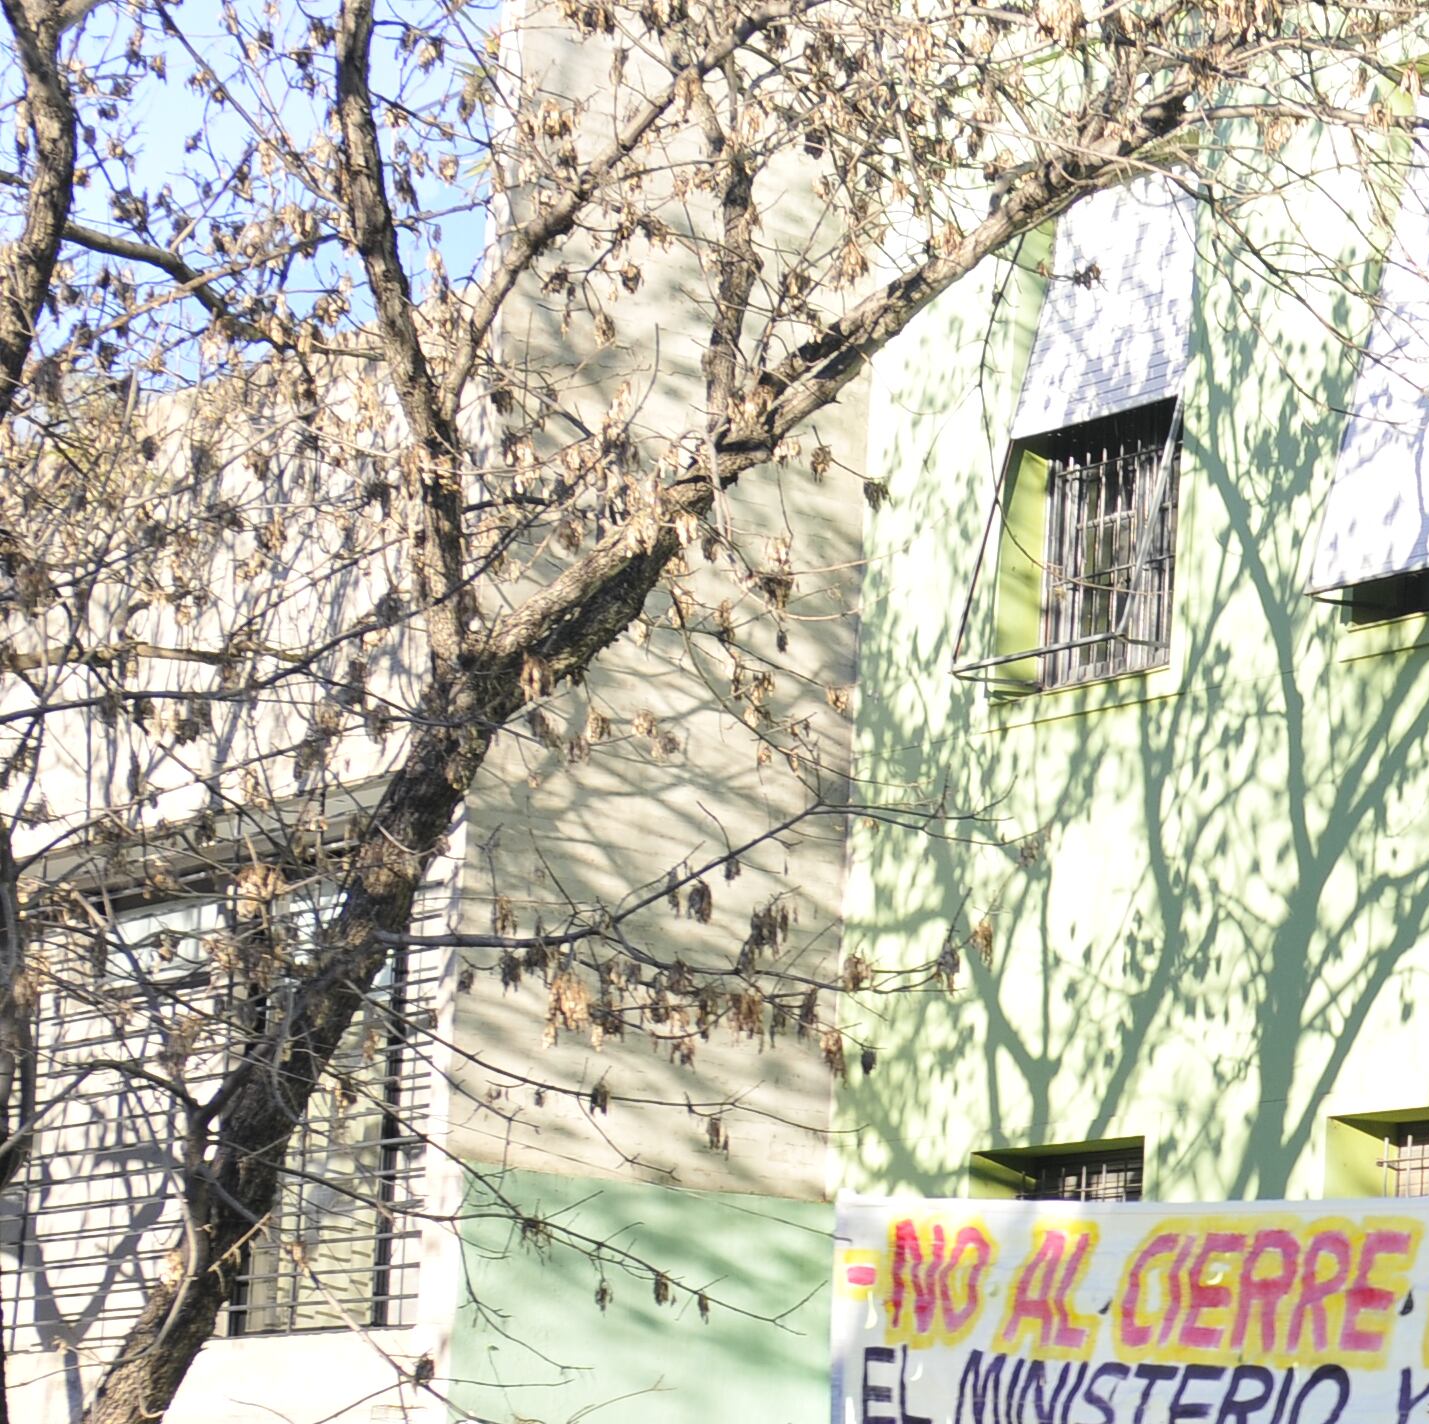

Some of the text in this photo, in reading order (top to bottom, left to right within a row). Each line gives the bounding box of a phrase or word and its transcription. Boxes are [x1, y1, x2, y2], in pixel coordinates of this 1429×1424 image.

[889, 1217, 988, 1334] NO
[1002, 1229, 1088, 1351] AL
[1121, 1228, 1414, 1354] CIERRE
